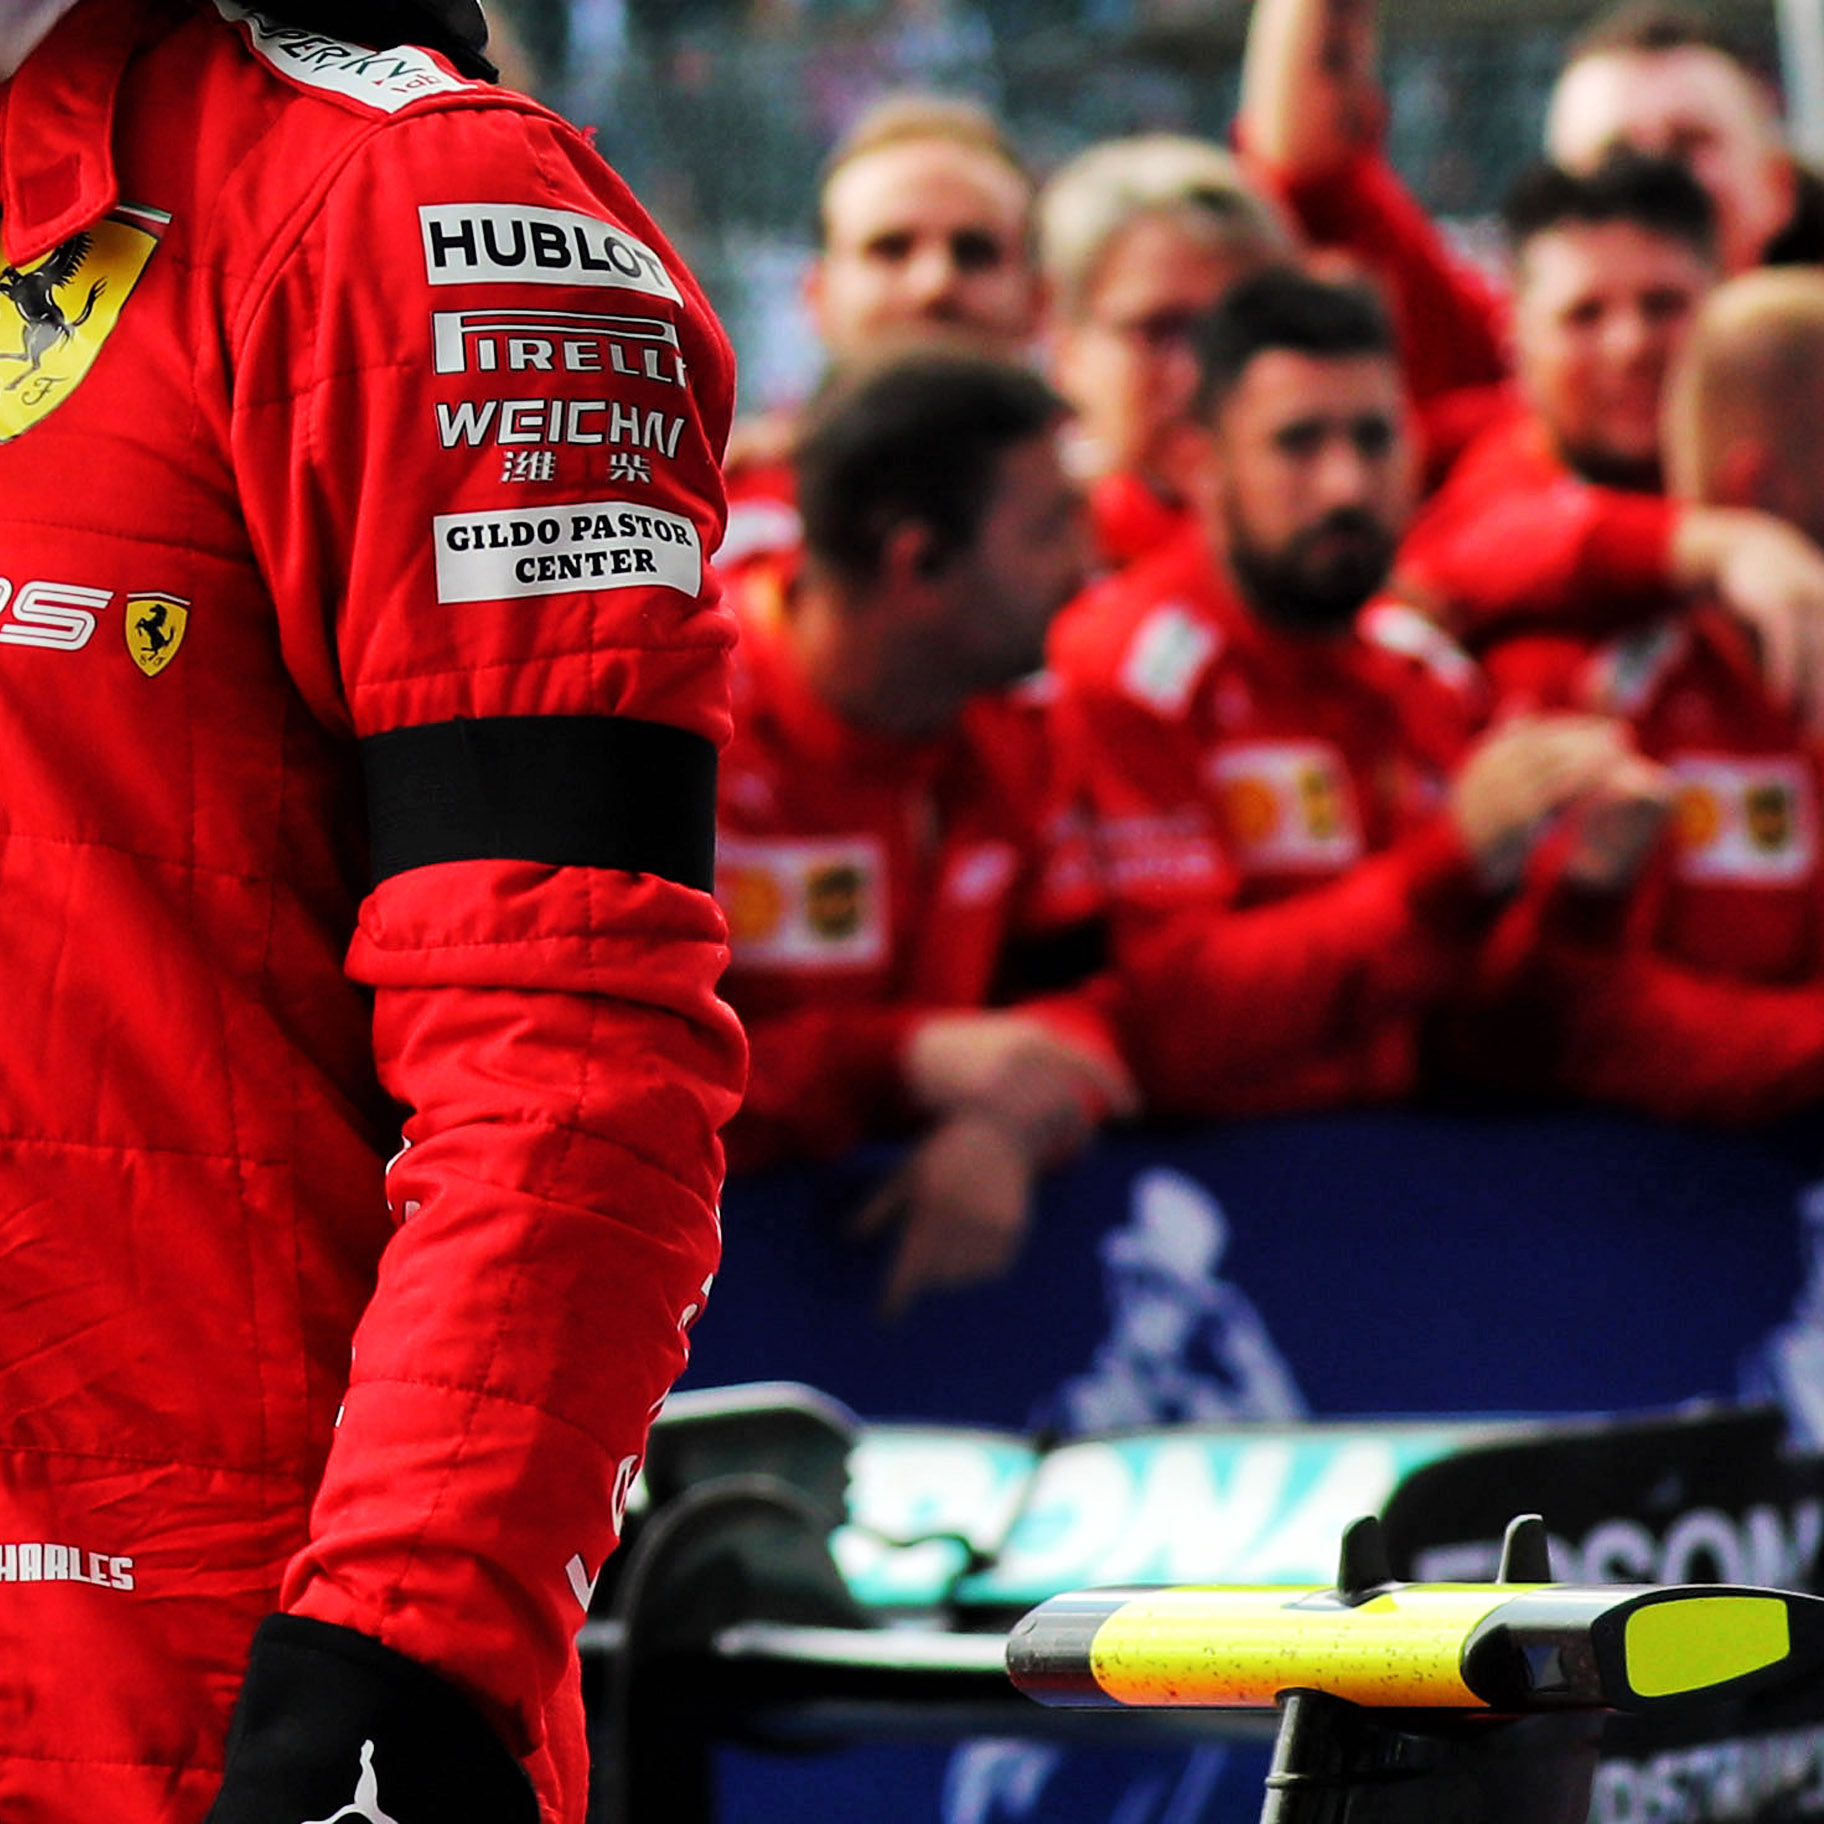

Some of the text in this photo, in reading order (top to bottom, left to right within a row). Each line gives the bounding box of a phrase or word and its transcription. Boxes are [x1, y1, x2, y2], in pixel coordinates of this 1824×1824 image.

[428, 219, 666, 288] HUBLOT
[433, 309, 687, 390] PIRELLI
[446, 512, 694, 552] GILDO PASTOR
[514, 547, 658, 585] CENTER
